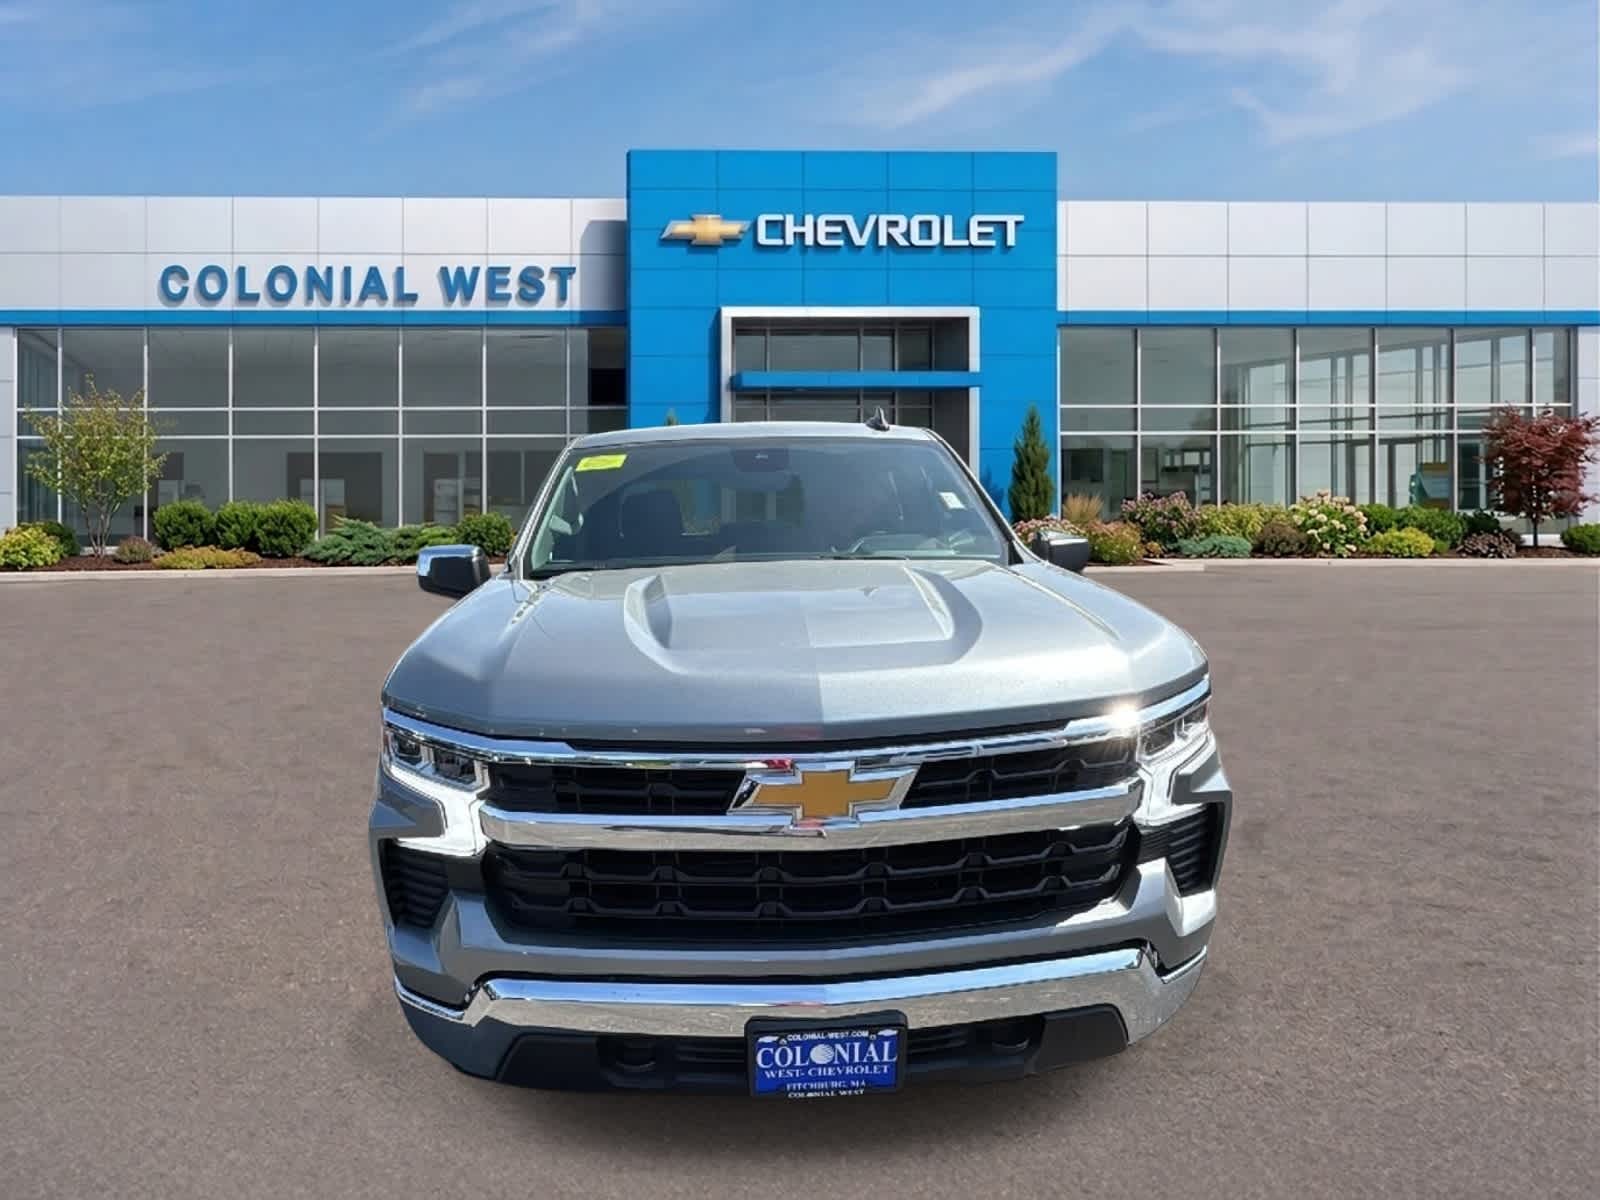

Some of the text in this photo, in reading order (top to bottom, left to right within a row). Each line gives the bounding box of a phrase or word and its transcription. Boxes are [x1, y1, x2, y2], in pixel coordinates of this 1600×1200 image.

[756, 213, 1025, 248] CHEVROLET
[159, 265, 577, 307] COLONIAL WEST
[756, 1041, 898, 1069] COLONIAL
[807, 1065, 889, 1077] CHEVROLET
[788, 1091, 836, 1099] COLONIAL
